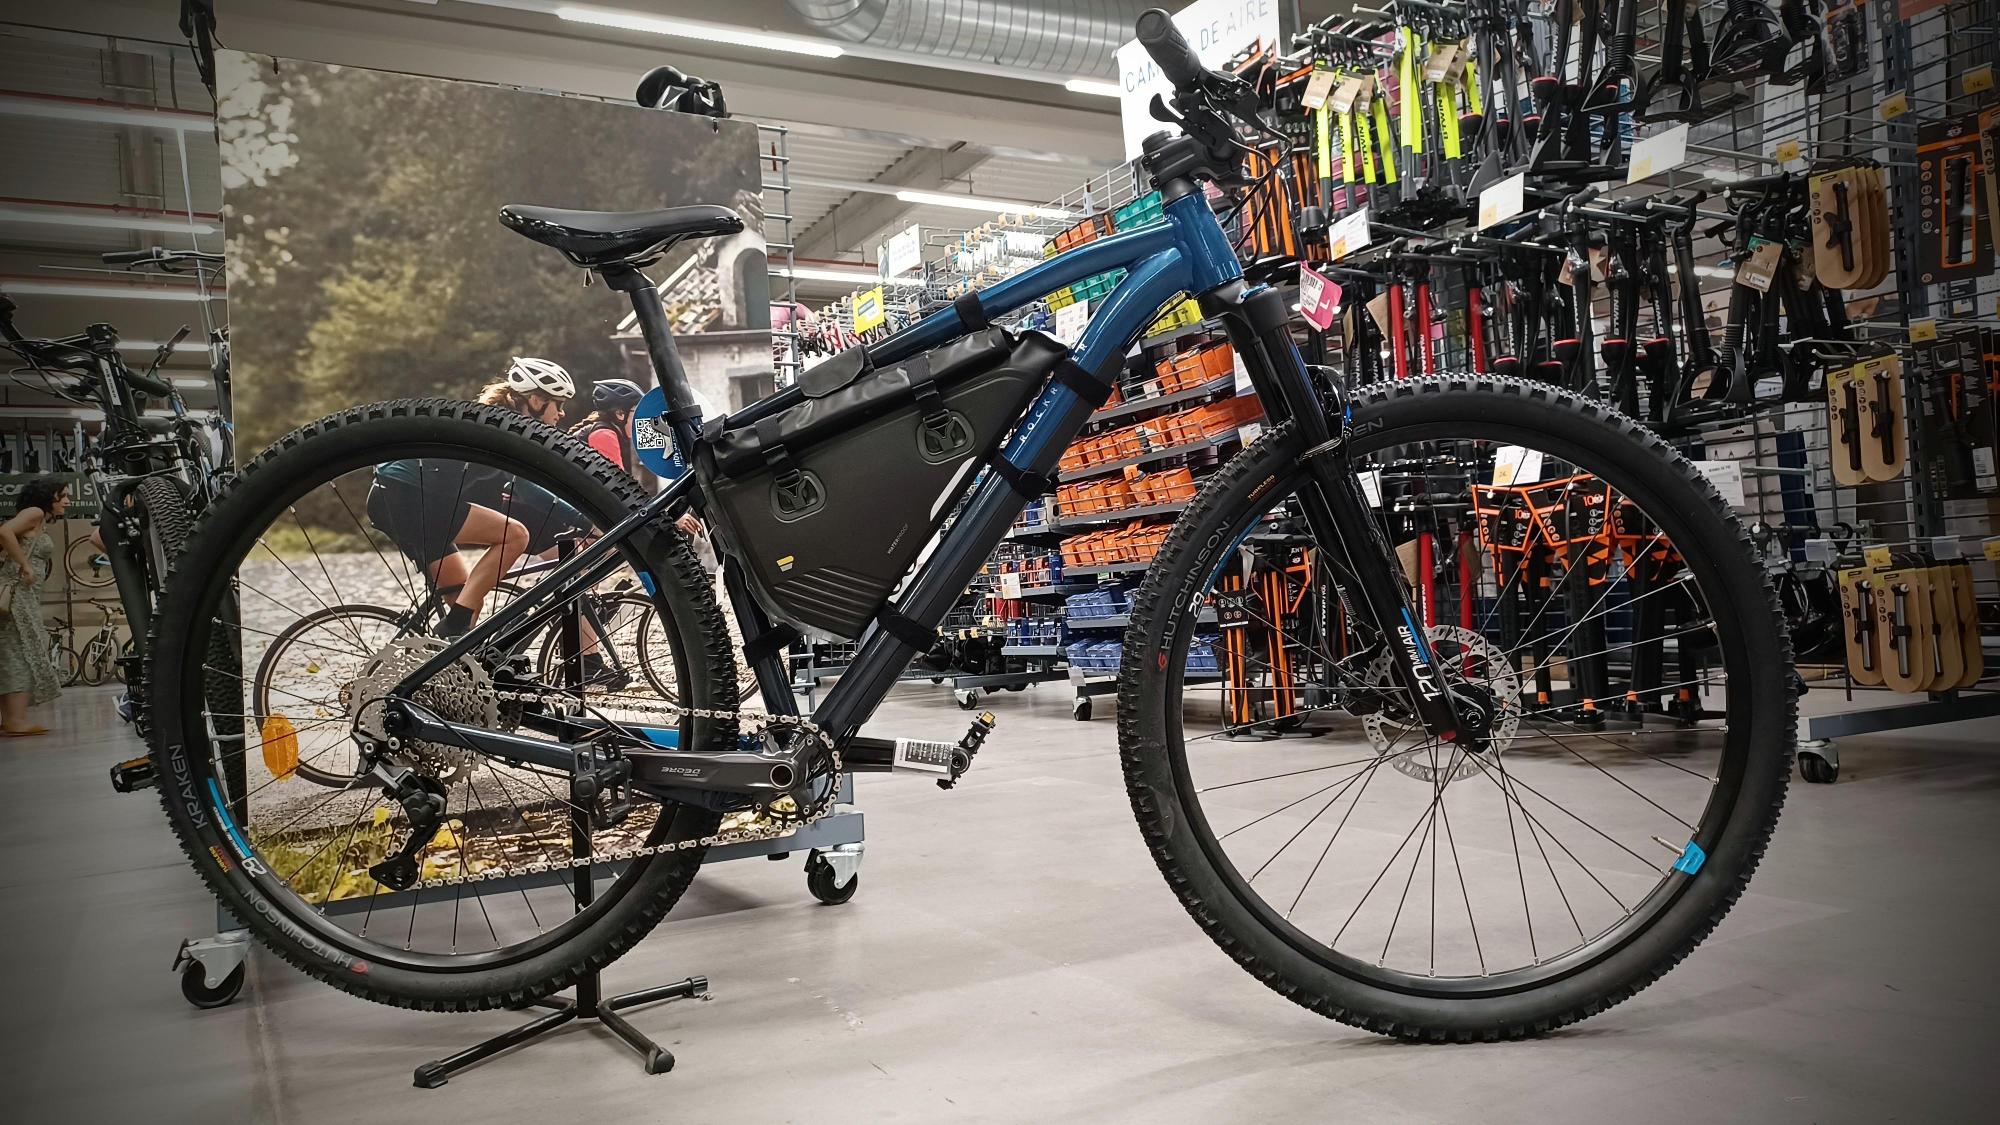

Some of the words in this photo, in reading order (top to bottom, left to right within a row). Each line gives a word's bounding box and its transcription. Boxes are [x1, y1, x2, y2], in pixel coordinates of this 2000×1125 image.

[1200, 20, 1220, 51] DE
[1226, 0, 1269, 37] AIRE
[1319, 299, 1330, 310] L
[1019, 343, 1088, 443] ROCKRER
[1160, 519, 1230, 651] HUTCHINSON
[1187, 591, 1205, 619] 29
[169, 744, 208, 830] KRAKEN
[660, 766, 702, 775] DEORE
[241, 856, 268, 878] 29
[243, 888, 353, 968] HUTCHINSON
